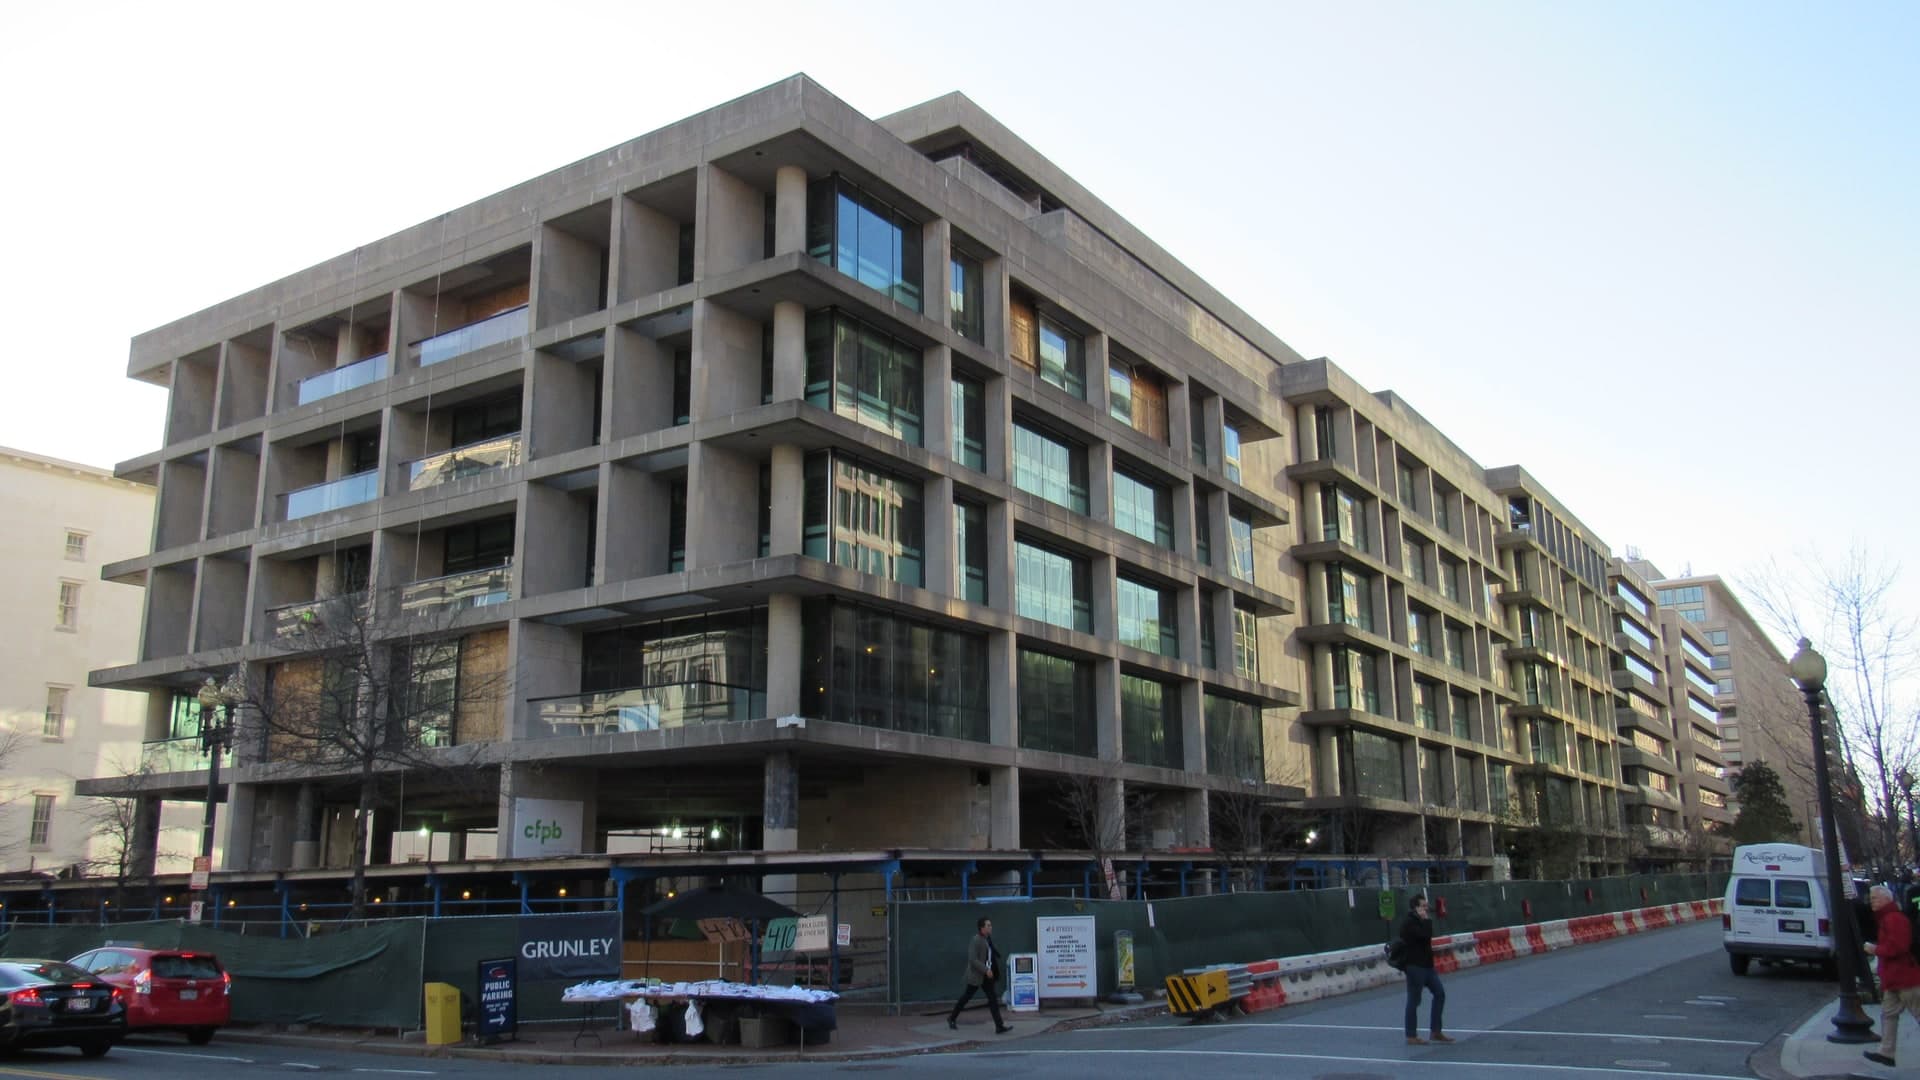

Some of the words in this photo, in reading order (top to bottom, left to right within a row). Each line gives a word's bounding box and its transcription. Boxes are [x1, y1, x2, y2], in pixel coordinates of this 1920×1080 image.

[524, 819, 562, 845] cfpb
[521, 938, 613, 959] GRUNLEY
[485, 980, 510, 991] PUBLIC
[482, 990, 513, 1001] PARKING
